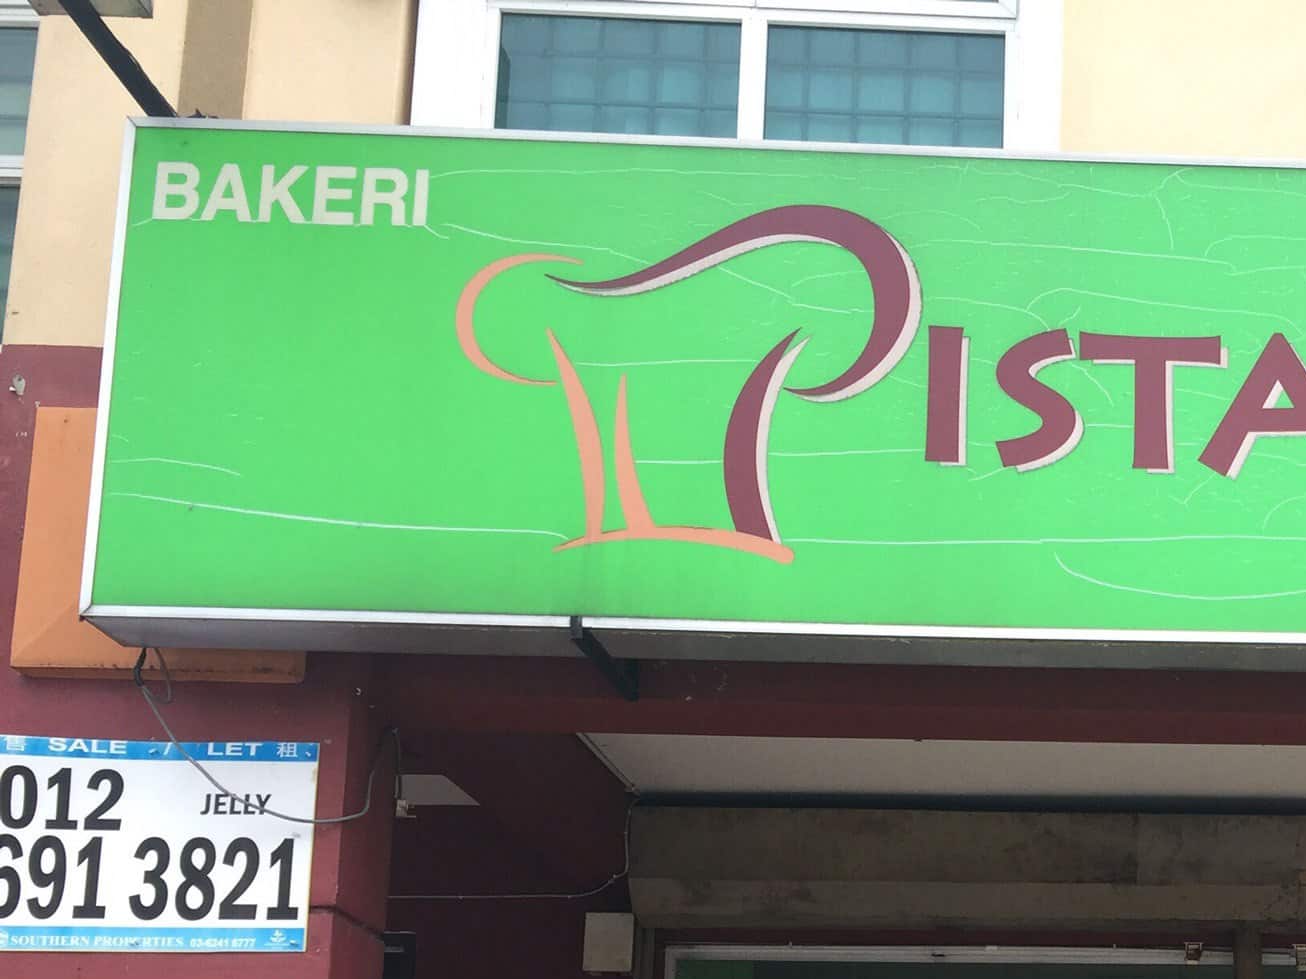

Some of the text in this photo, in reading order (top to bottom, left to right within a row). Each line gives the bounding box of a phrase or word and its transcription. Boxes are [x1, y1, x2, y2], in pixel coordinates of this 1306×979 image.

[151, 161, 430, 228] BAKERI
[48, 737, 128, 755] SALE
[207, 741, 264, 757] LET
[0, 765, 125, 830] 012
[200, 793, 272, 816] JELLY
[128, 836, 299, 921] 3821
[11, 935, 90, 947] SOUTHERN
[94, 935, 184, 948] PROPERTIES
